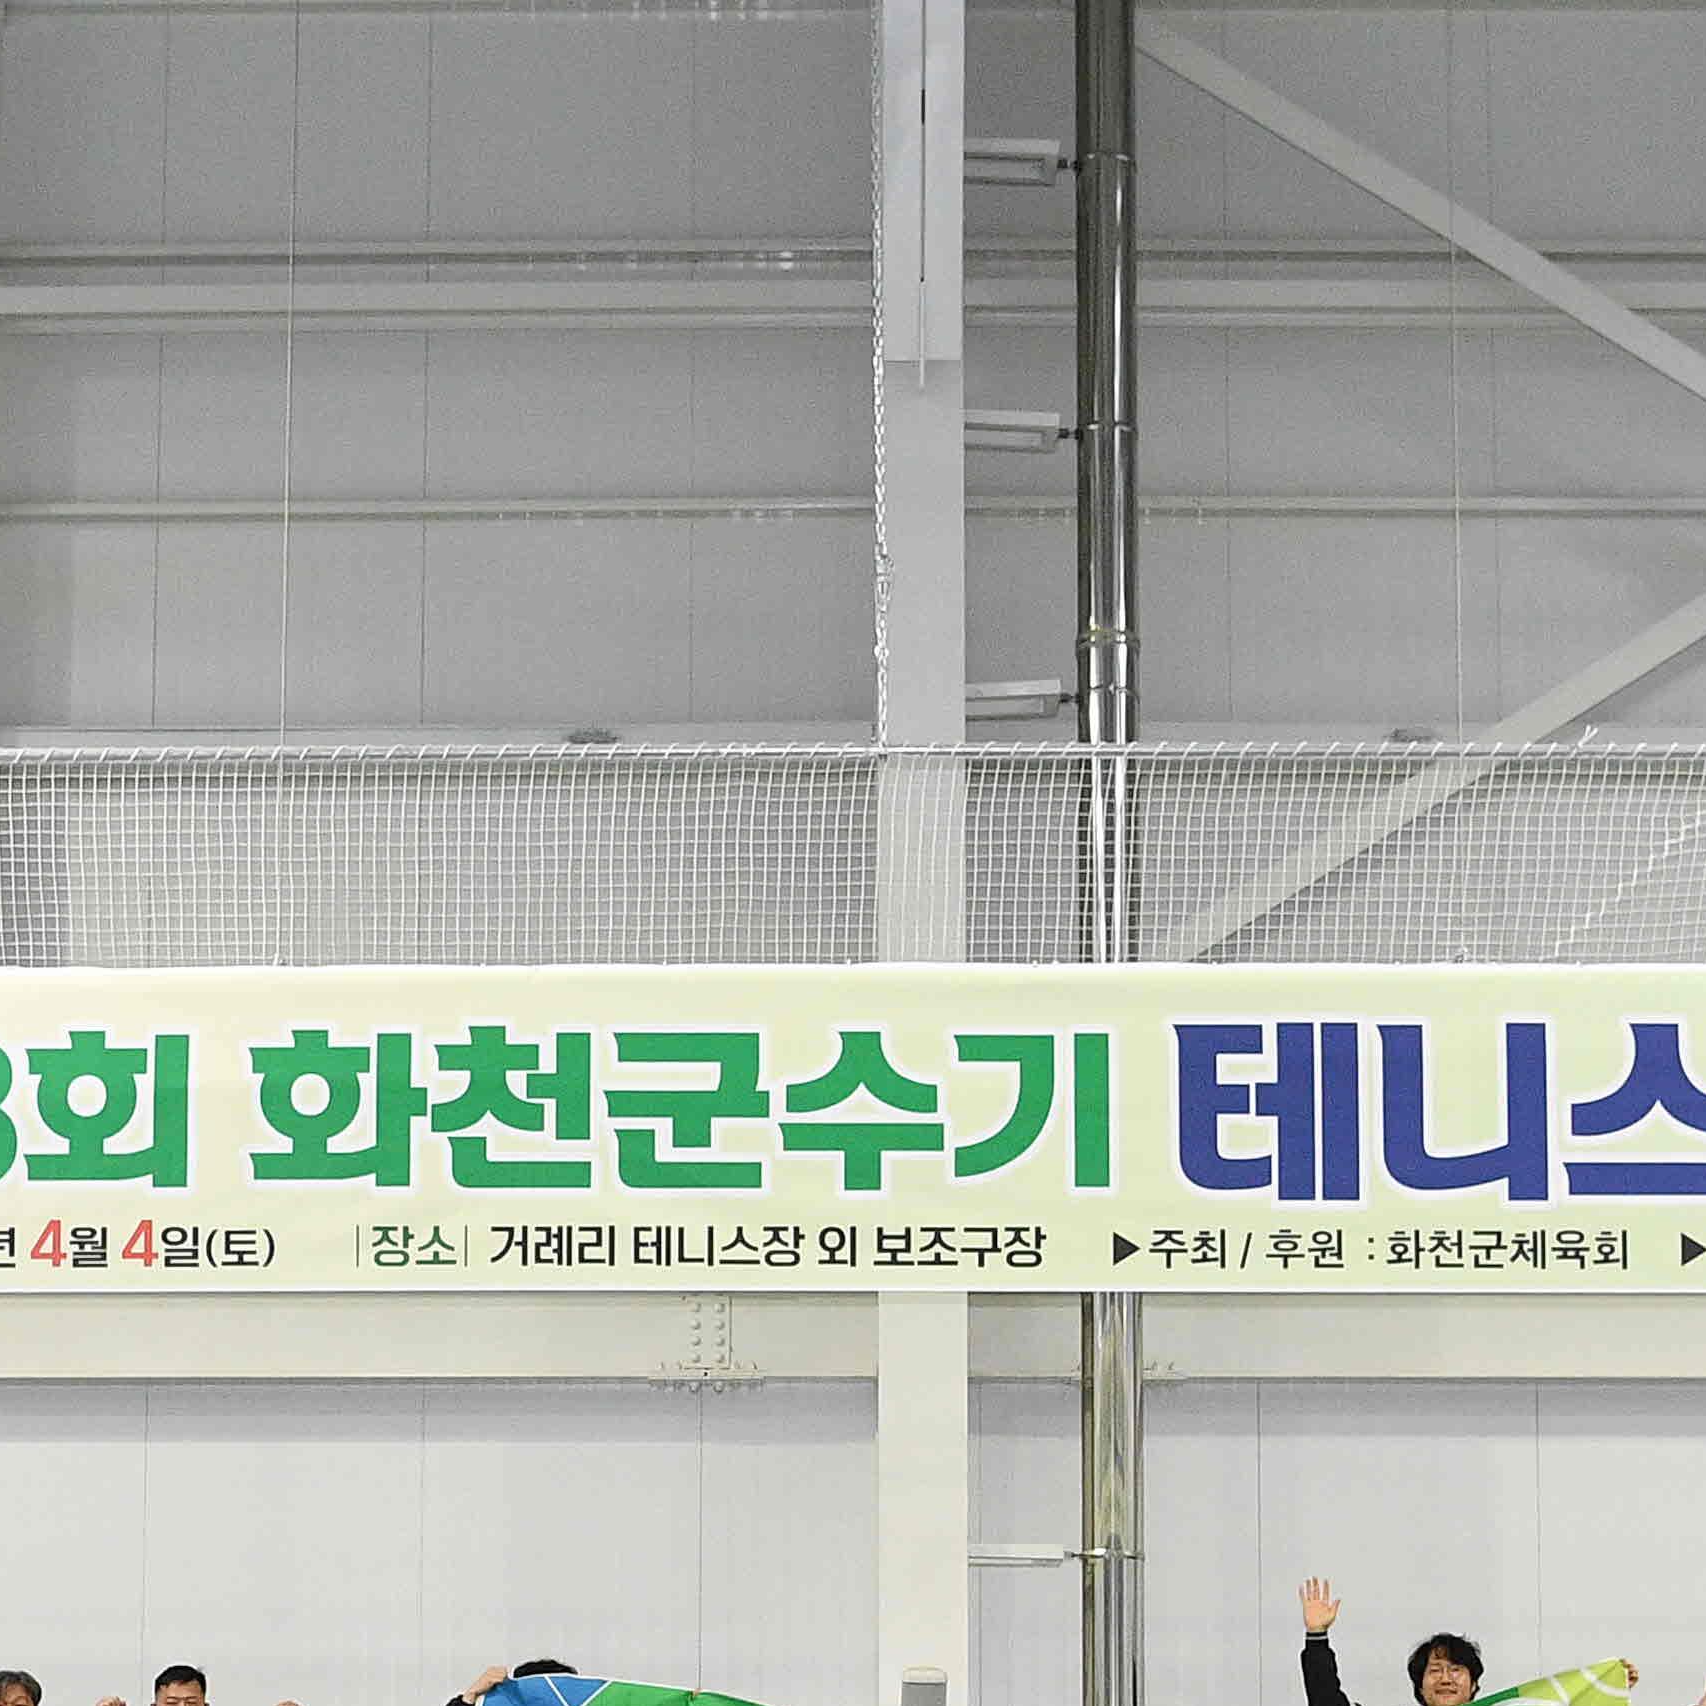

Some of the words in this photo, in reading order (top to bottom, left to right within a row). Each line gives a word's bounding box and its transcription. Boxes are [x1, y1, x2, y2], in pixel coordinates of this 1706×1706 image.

[248, 1025, 1111, 1191] 화천군수기
[30, 1219, 109, 1268] 4월
[121, 1219, 275, 1268] 4일(토)
[371, 1225, 457, 1267] 장소
[490, 1225, 616, 1267] 거례리
[633, 1225, 806, 1267] 테니스장
[817, 1226, 857, 1268] 외
[873, 1226, 1047, 1268] 보조구장
[1148, 1229, 1226, 1270] 주최
[1265, 1229, 1345, 1270] 후원
[1385, 1229, 1628, 1270] 화천군체육회
